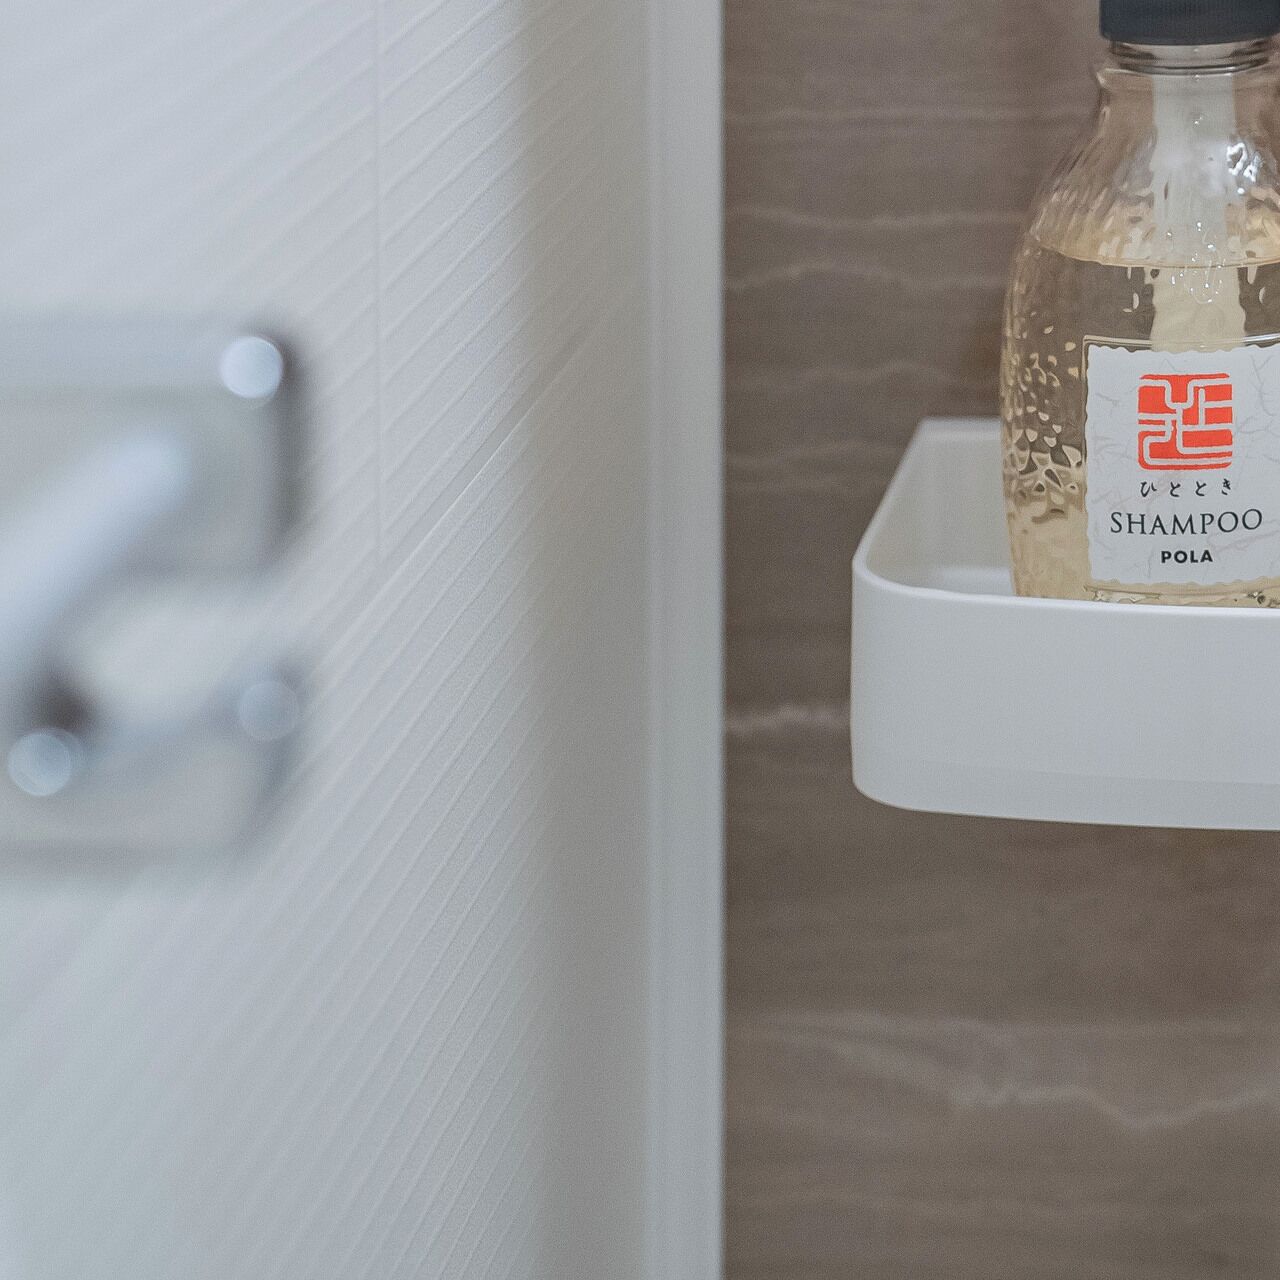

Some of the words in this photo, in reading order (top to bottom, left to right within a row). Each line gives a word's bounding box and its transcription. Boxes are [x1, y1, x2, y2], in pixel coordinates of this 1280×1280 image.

[1140, 478, 1232, 498] ひととき
[1110, 508, 1263, 536] SHAMPOO
[1161, 549, 1213, 564] POLA
